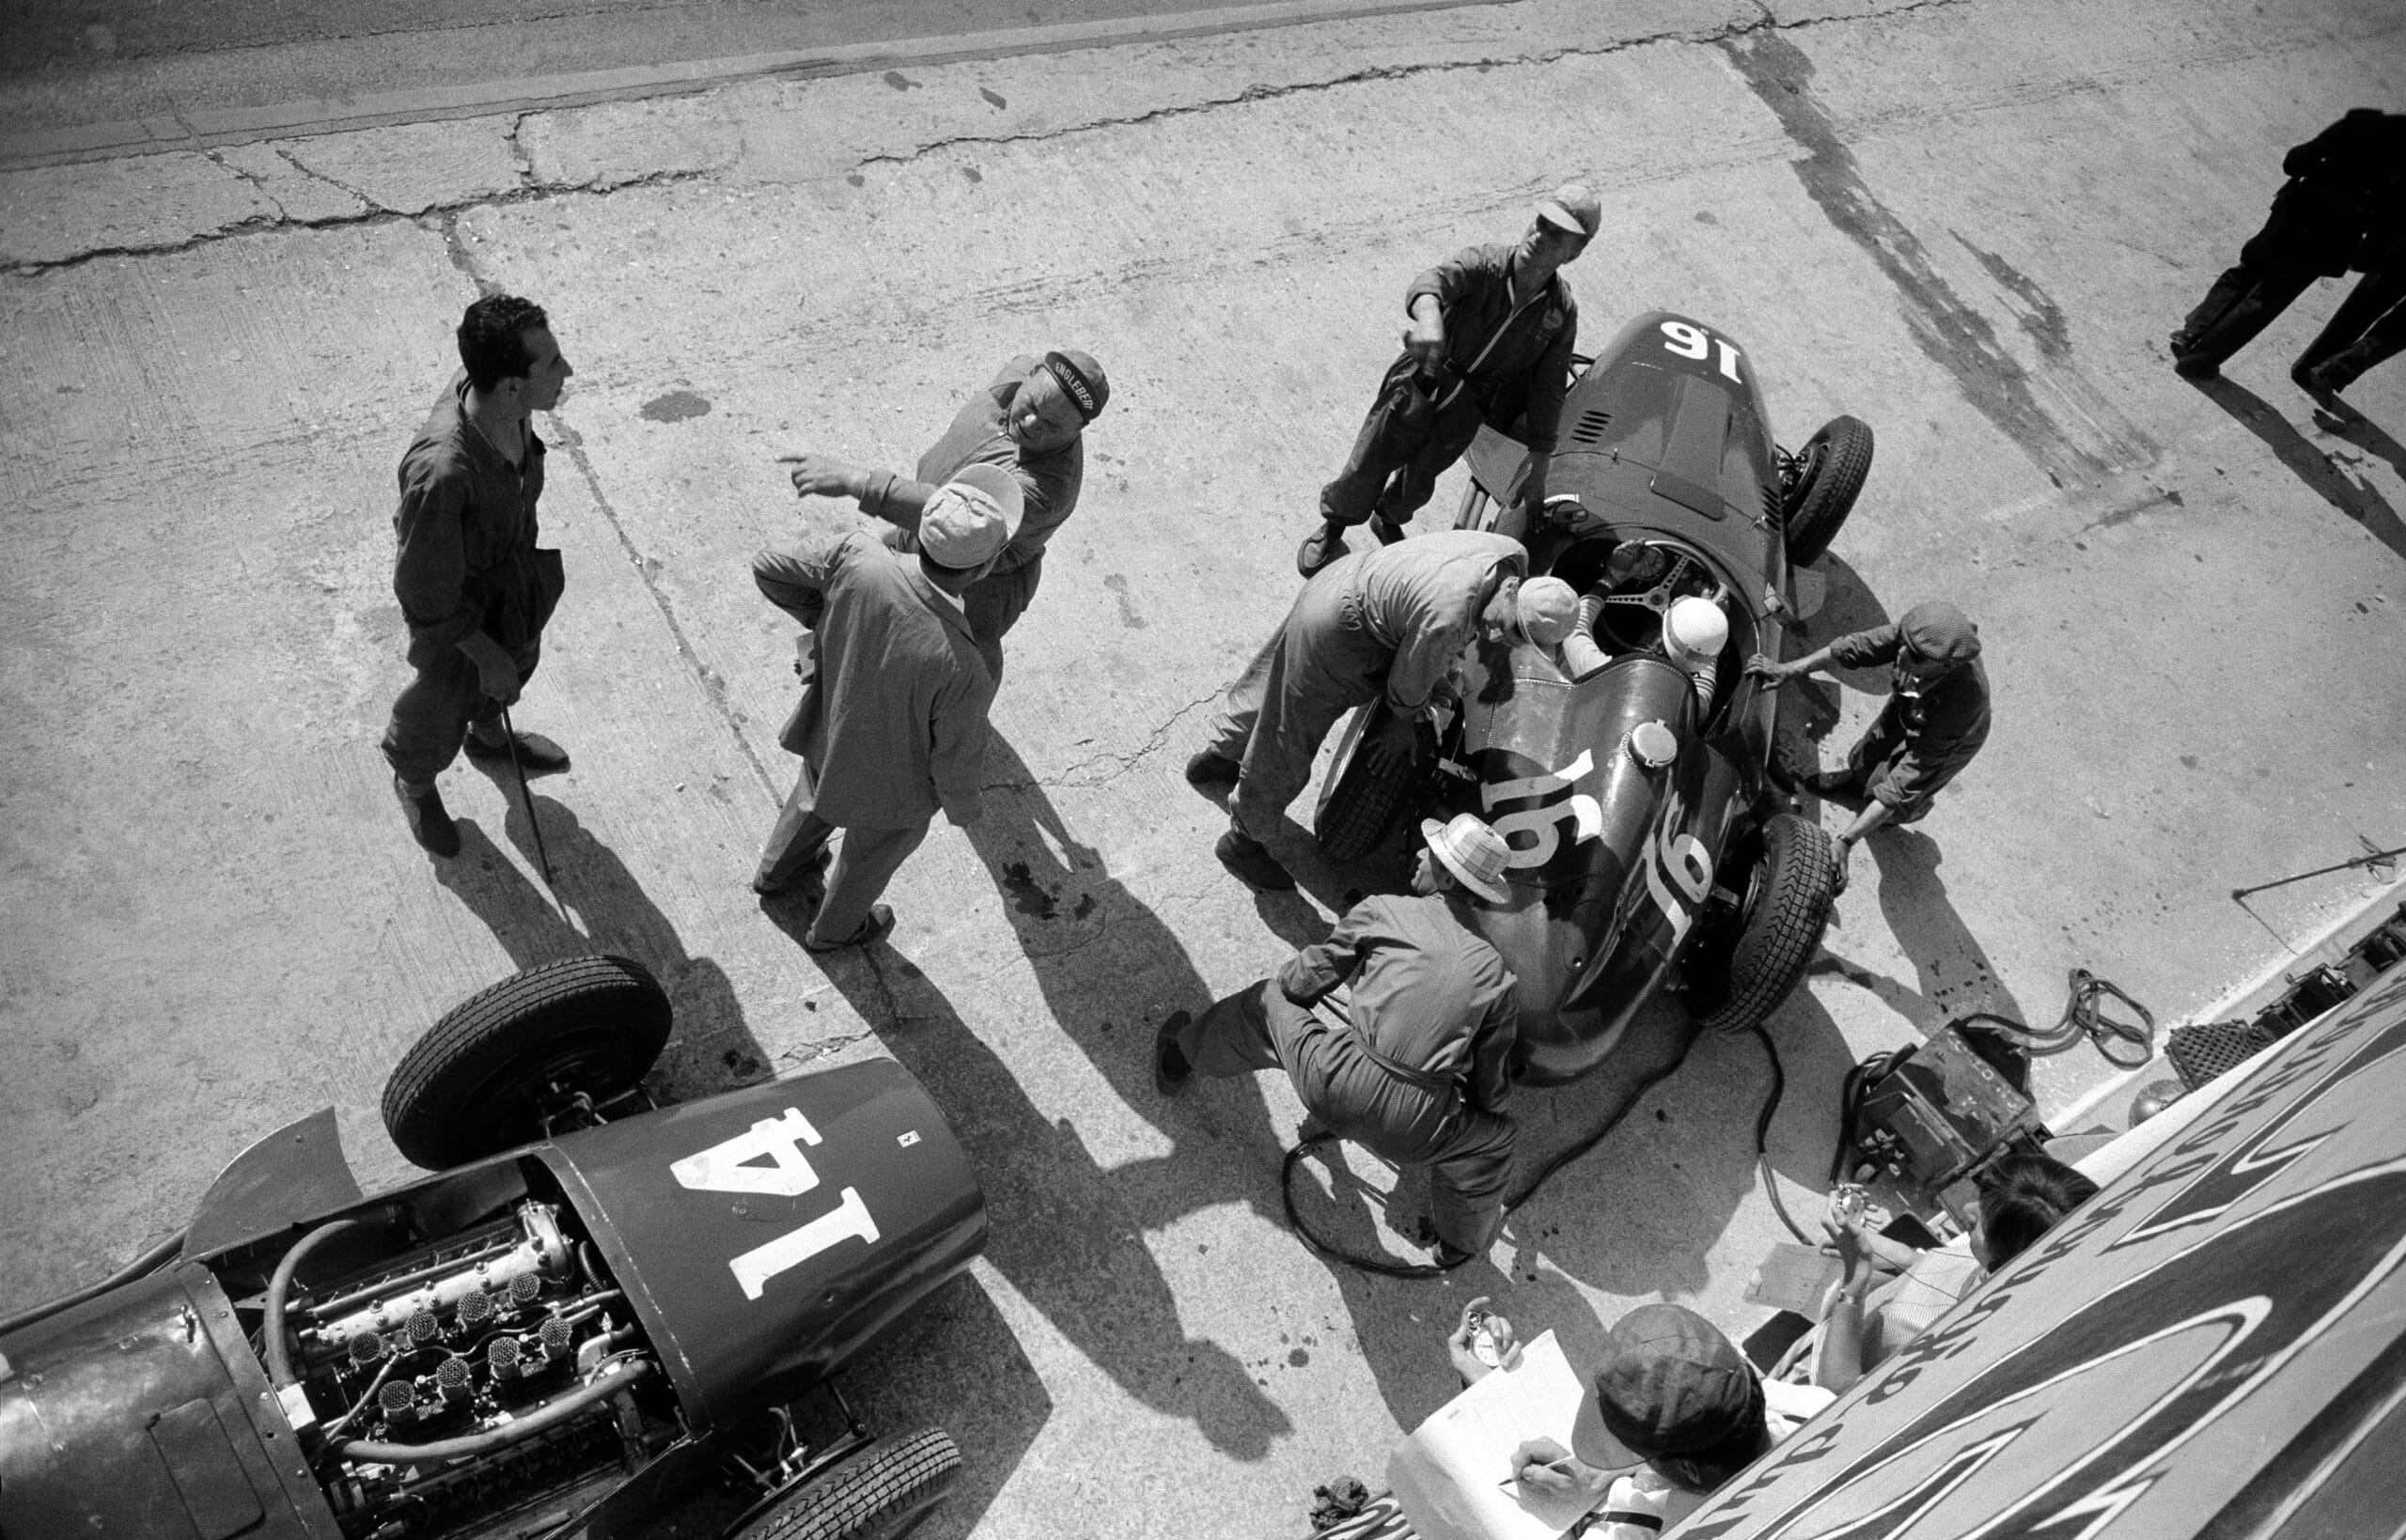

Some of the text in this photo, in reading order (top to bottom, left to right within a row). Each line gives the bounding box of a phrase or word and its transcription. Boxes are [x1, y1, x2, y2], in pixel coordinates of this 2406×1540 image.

[1054, 361, 1094, 411] ENGLEBERT
[1660, 320, 1742, 385] 16
[1480, 749, 1602, 869] 16
[1643, 791, 1713, 948] 16
[669, 1107, 881, 1300] 14
